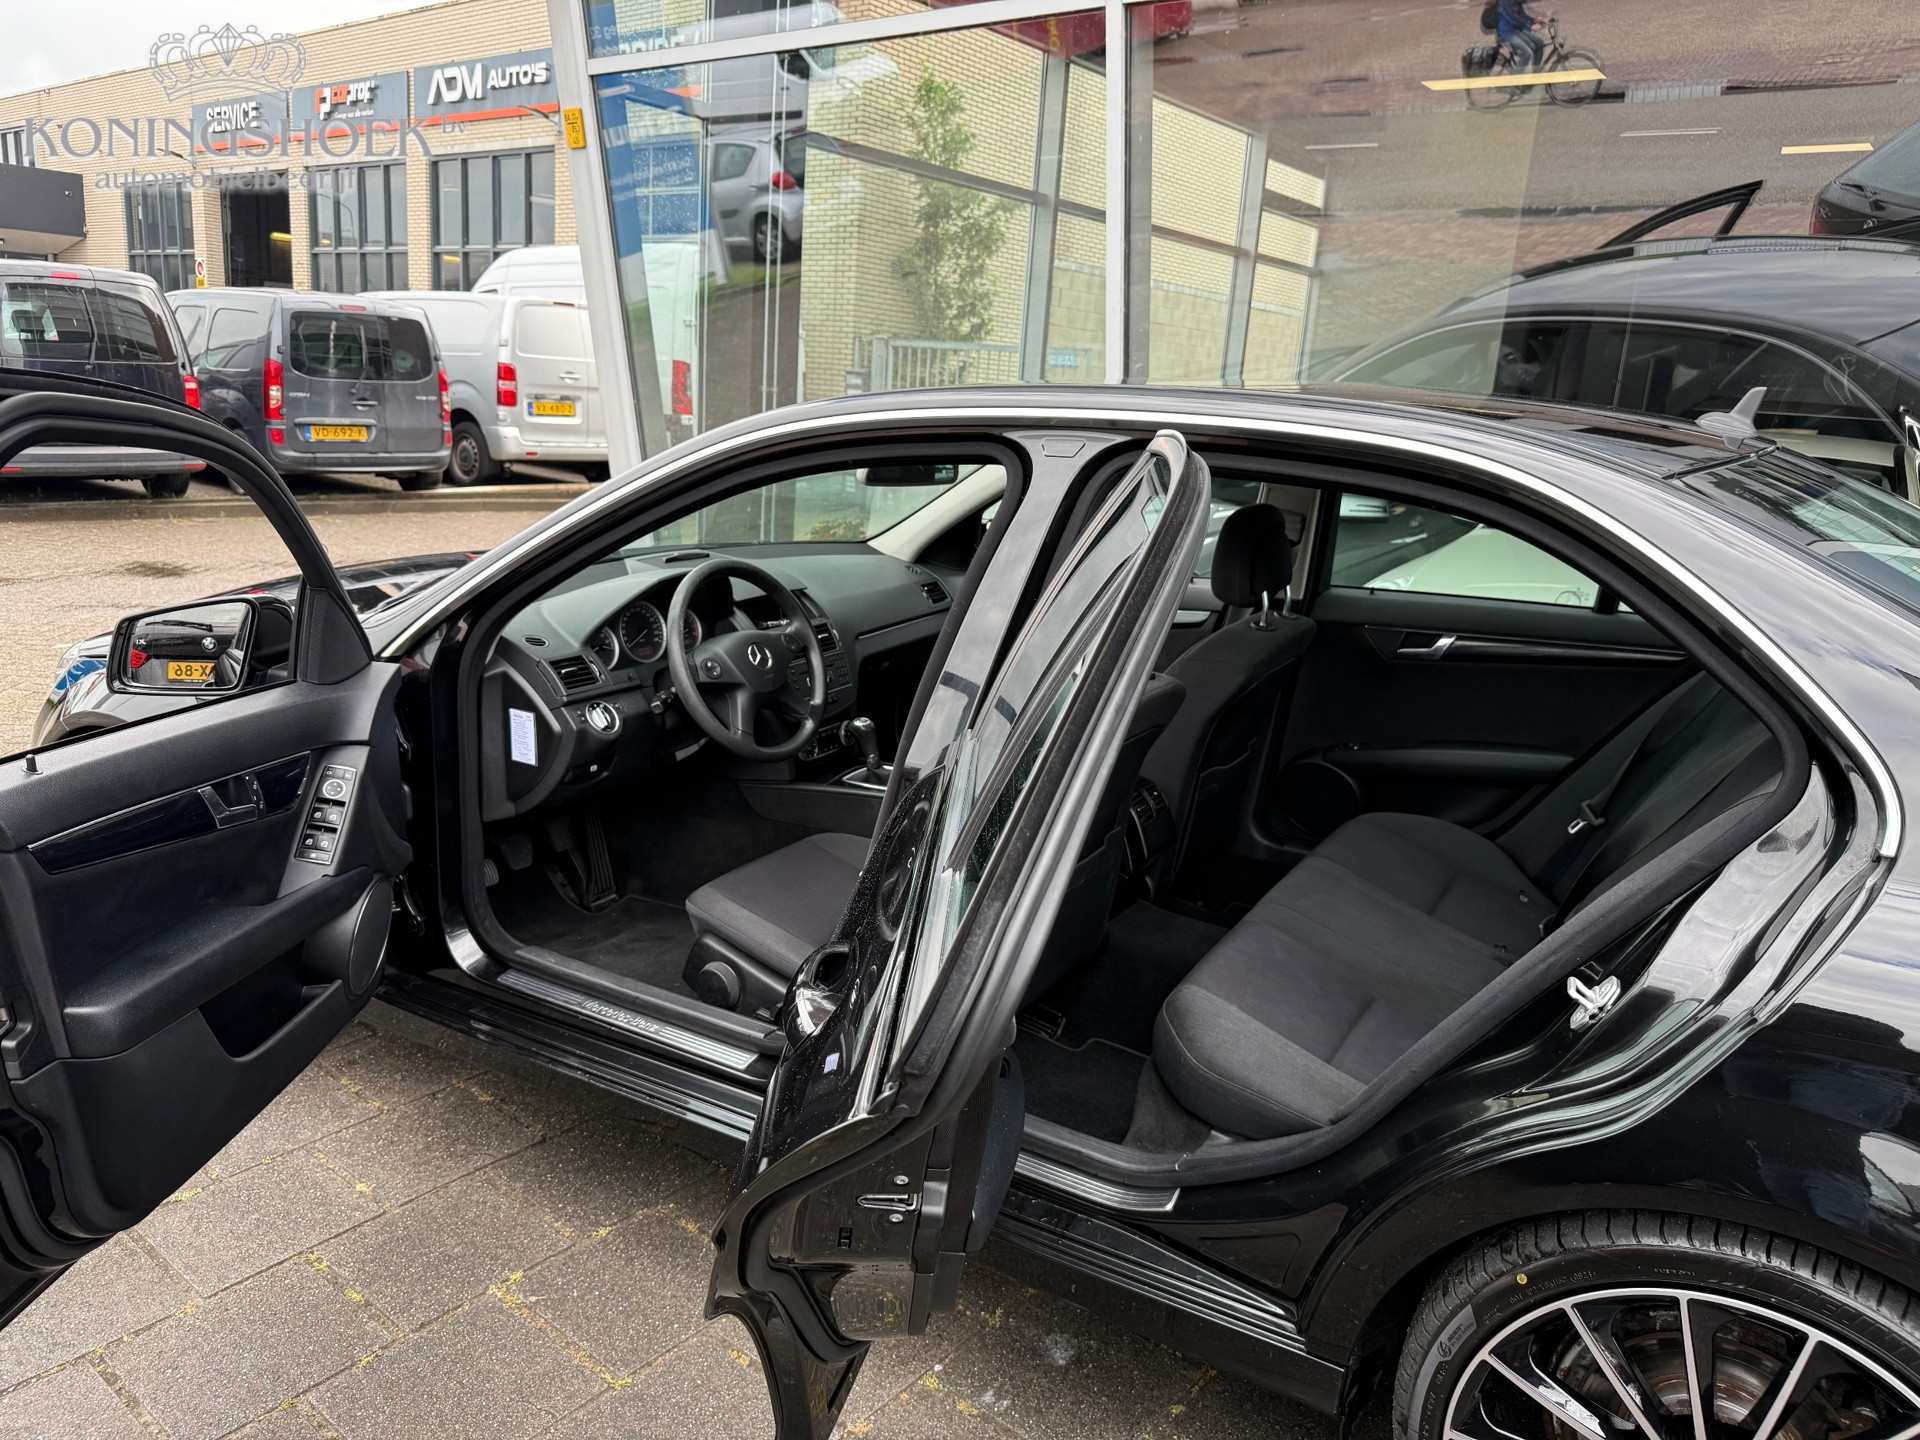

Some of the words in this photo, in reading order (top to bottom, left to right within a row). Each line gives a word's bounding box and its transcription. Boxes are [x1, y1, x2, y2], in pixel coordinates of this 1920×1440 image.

[427, 62, 483, 105] ADM
[487, 61, 547, 89] AUTO'S
[206, 101, 259, 133] SERVICE
[313, 425, 364, 438] VD-692-K
